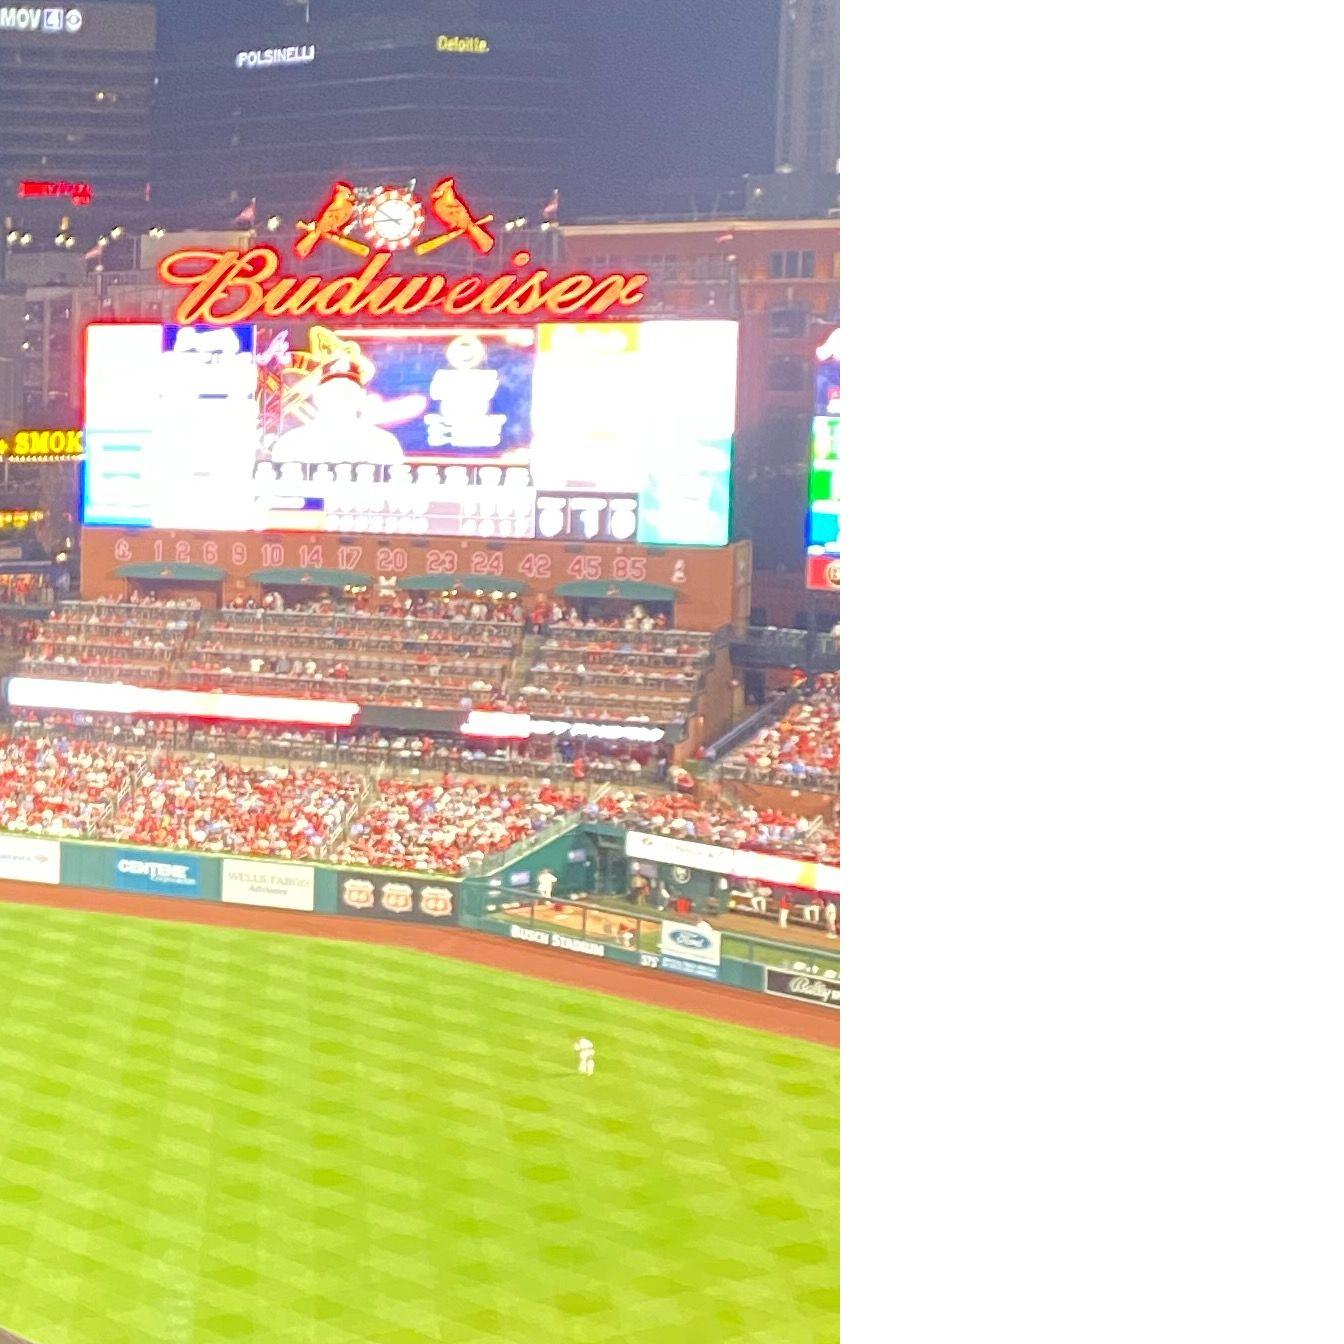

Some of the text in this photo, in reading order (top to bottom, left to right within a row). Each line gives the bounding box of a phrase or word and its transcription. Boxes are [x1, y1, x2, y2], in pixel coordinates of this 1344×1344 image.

[236, 44, 315, 67] POLSINELLI
[158, 247, 649, 325] Budweiser
[14, 429, 84, 455] SMOK
[175, 541, 190, 563] 2
[203, 541, 218, 564] 6
[231, 542, 247, 565] 9
[262, 543, 284, 567] 10
[299, 544, 323, 569] 14
[337, 546, 362, 570] 17
[377, 548, 408, 572] 20
[426, 550, 458, 574] 23
[471, 551, 504, 575] 24
[519, 553, 551, 578] 42
[568, 555, 602, 580] 45
[612, 556, 646, 581] 85
[117, 858, 190, 878] CENTENE
